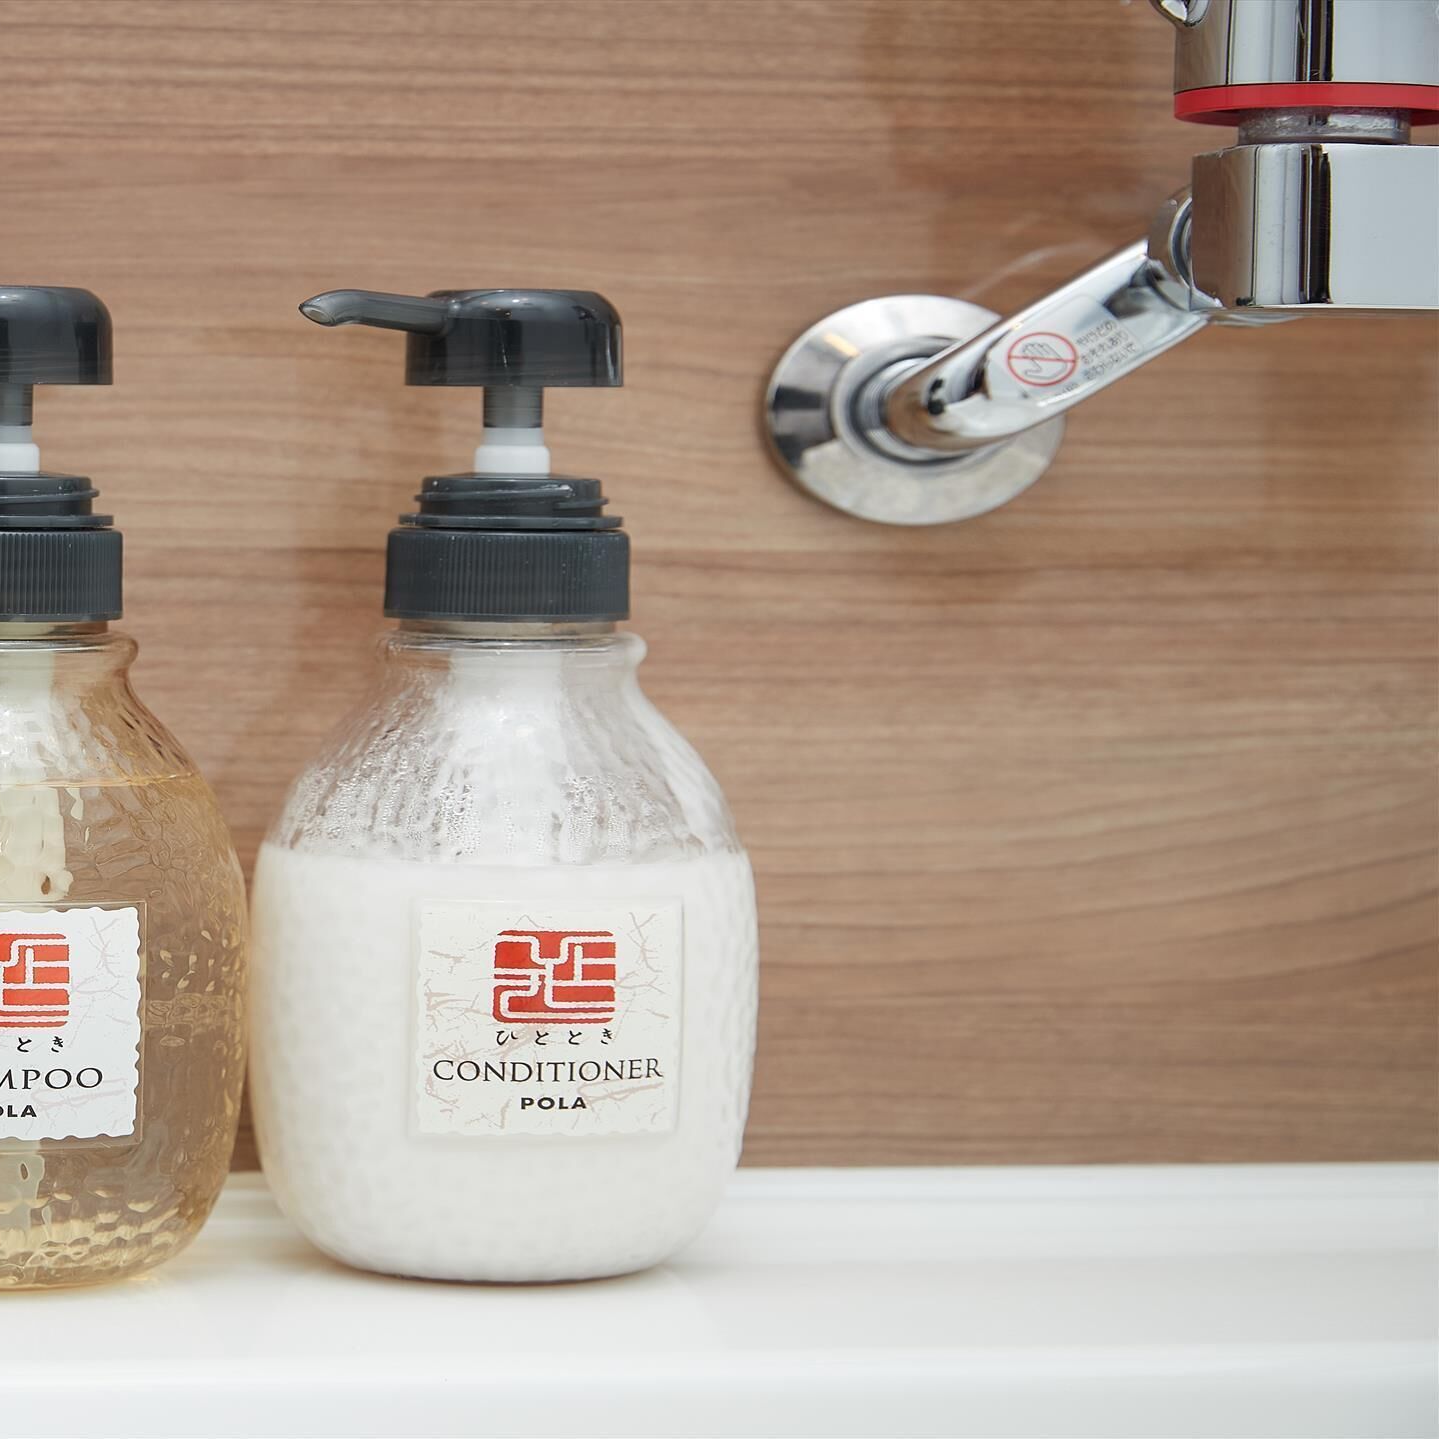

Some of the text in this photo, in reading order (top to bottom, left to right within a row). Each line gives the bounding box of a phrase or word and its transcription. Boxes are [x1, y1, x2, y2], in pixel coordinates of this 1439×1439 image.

[496, 1028, 612, 1046] ひととき
[433, 1058, 663, 1083] CONDITIONER
[520, 1096, 587, 1110] POLA
